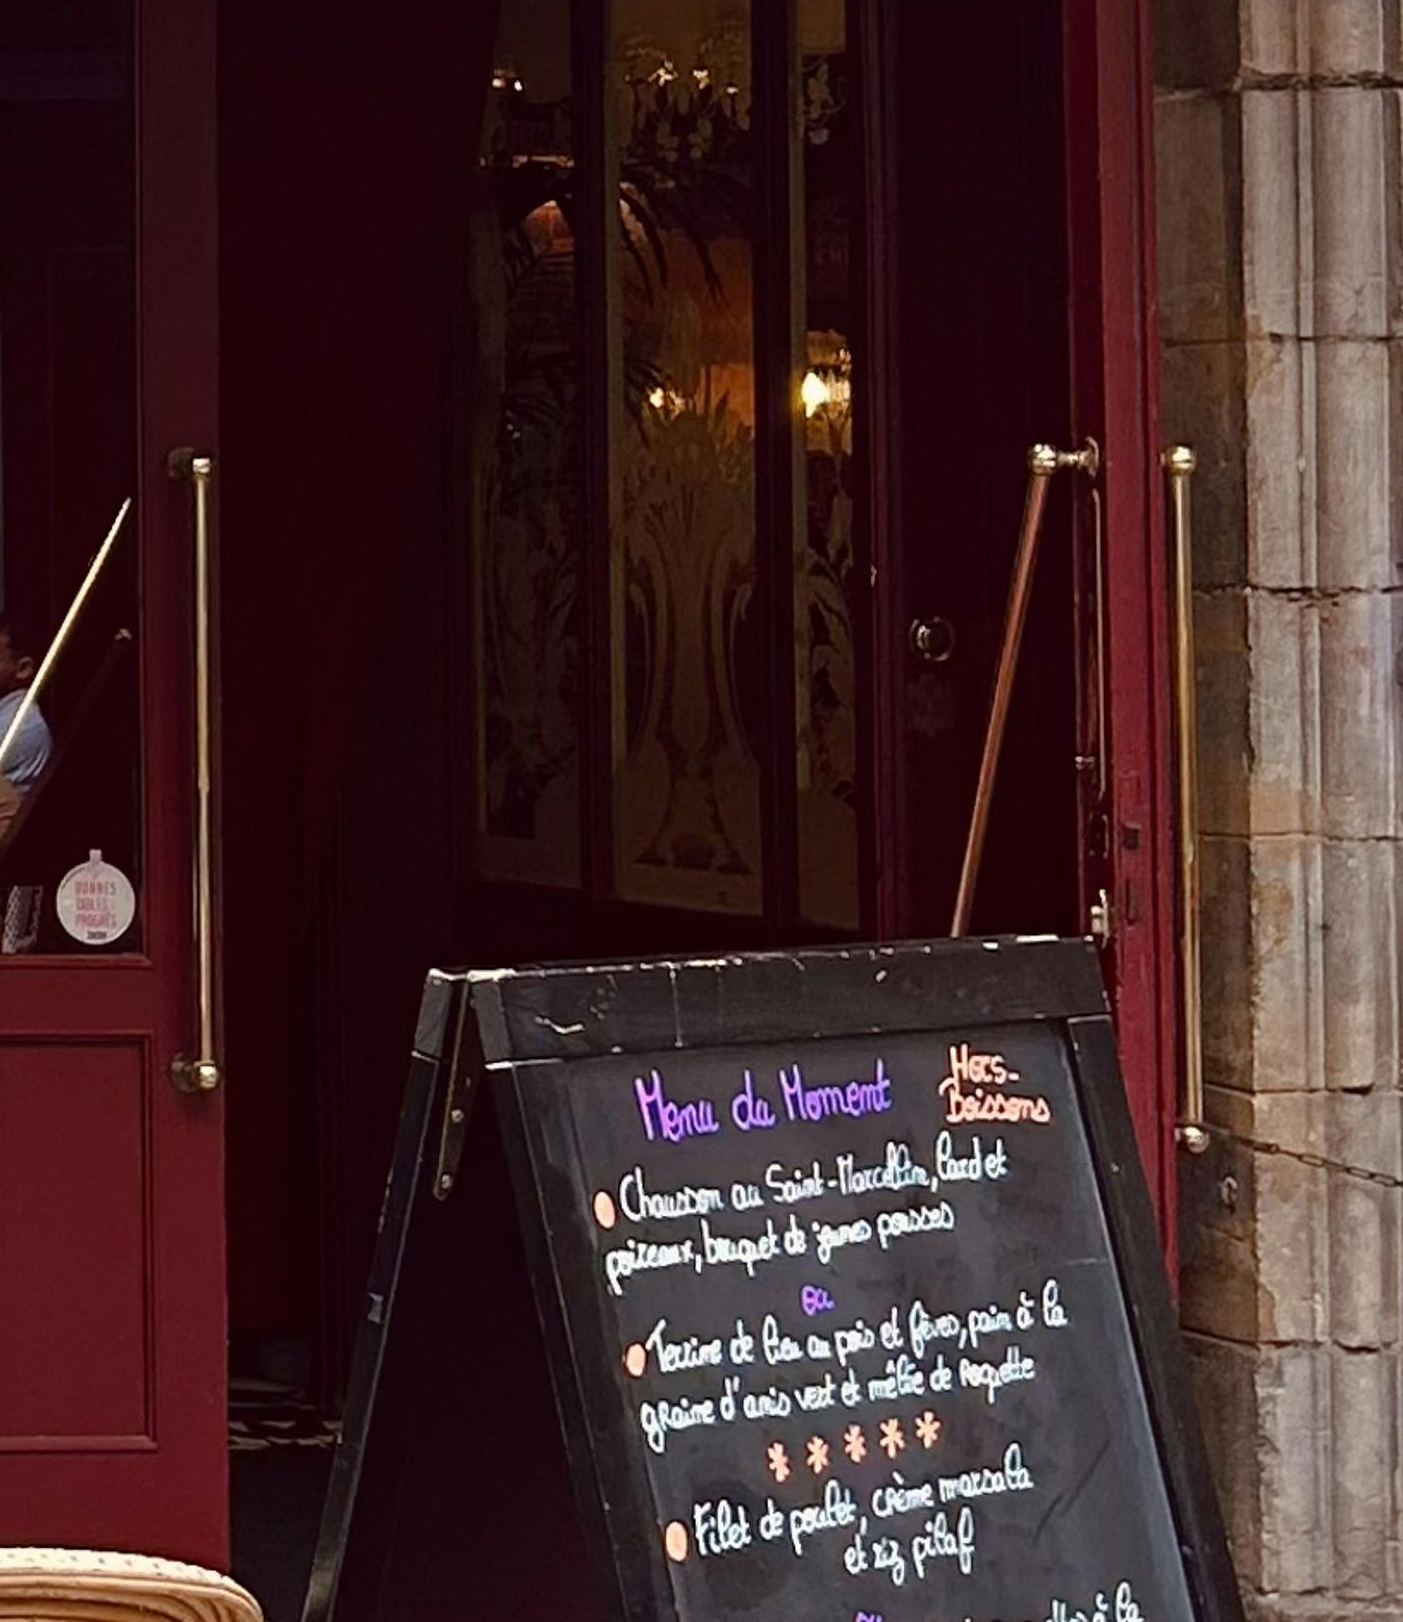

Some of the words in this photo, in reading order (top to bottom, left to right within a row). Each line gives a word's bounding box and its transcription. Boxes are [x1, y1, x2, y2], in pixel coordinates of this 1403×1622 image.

[634, 1069, 719, 1142] Menu
[731, 1069, 776, 1132] du
[779, 1058, 893, 1123] Moment
[938, 1076, 1052, 1124] Boissons
[620, 1165, 724, 1222] Chausson
[731, 1183, 764, 1210] au
[936, 1130, 982, 1182] lard
[984, 1137, 1011, 1180] et
[783, 1213, 807, 1255] de
[876, 1200, 955, 1250] pousses
[645, 1318, 723, 1373] Terrine
[729, 1318, 755, 1365] de
[879, 1306, 904, 1350] et
[968, 1305, 1012, 1349] pain
[1016, 1291, 1035, 1330] à
[1042, 1278, 1068, 1327] la
[840, 1367, 863, 1407] et
[929, 1354, 953, 1392] de
[693, 1498, 753, 1556] Filet
[759, 1498, 784, 1541] de
[938, 1442, 1035, 1502] marsala
[844, 1533, 869, 1575] et
[873, 1537, 905, 1586] riz
[911, 1507, 975, 1579] pilaf
